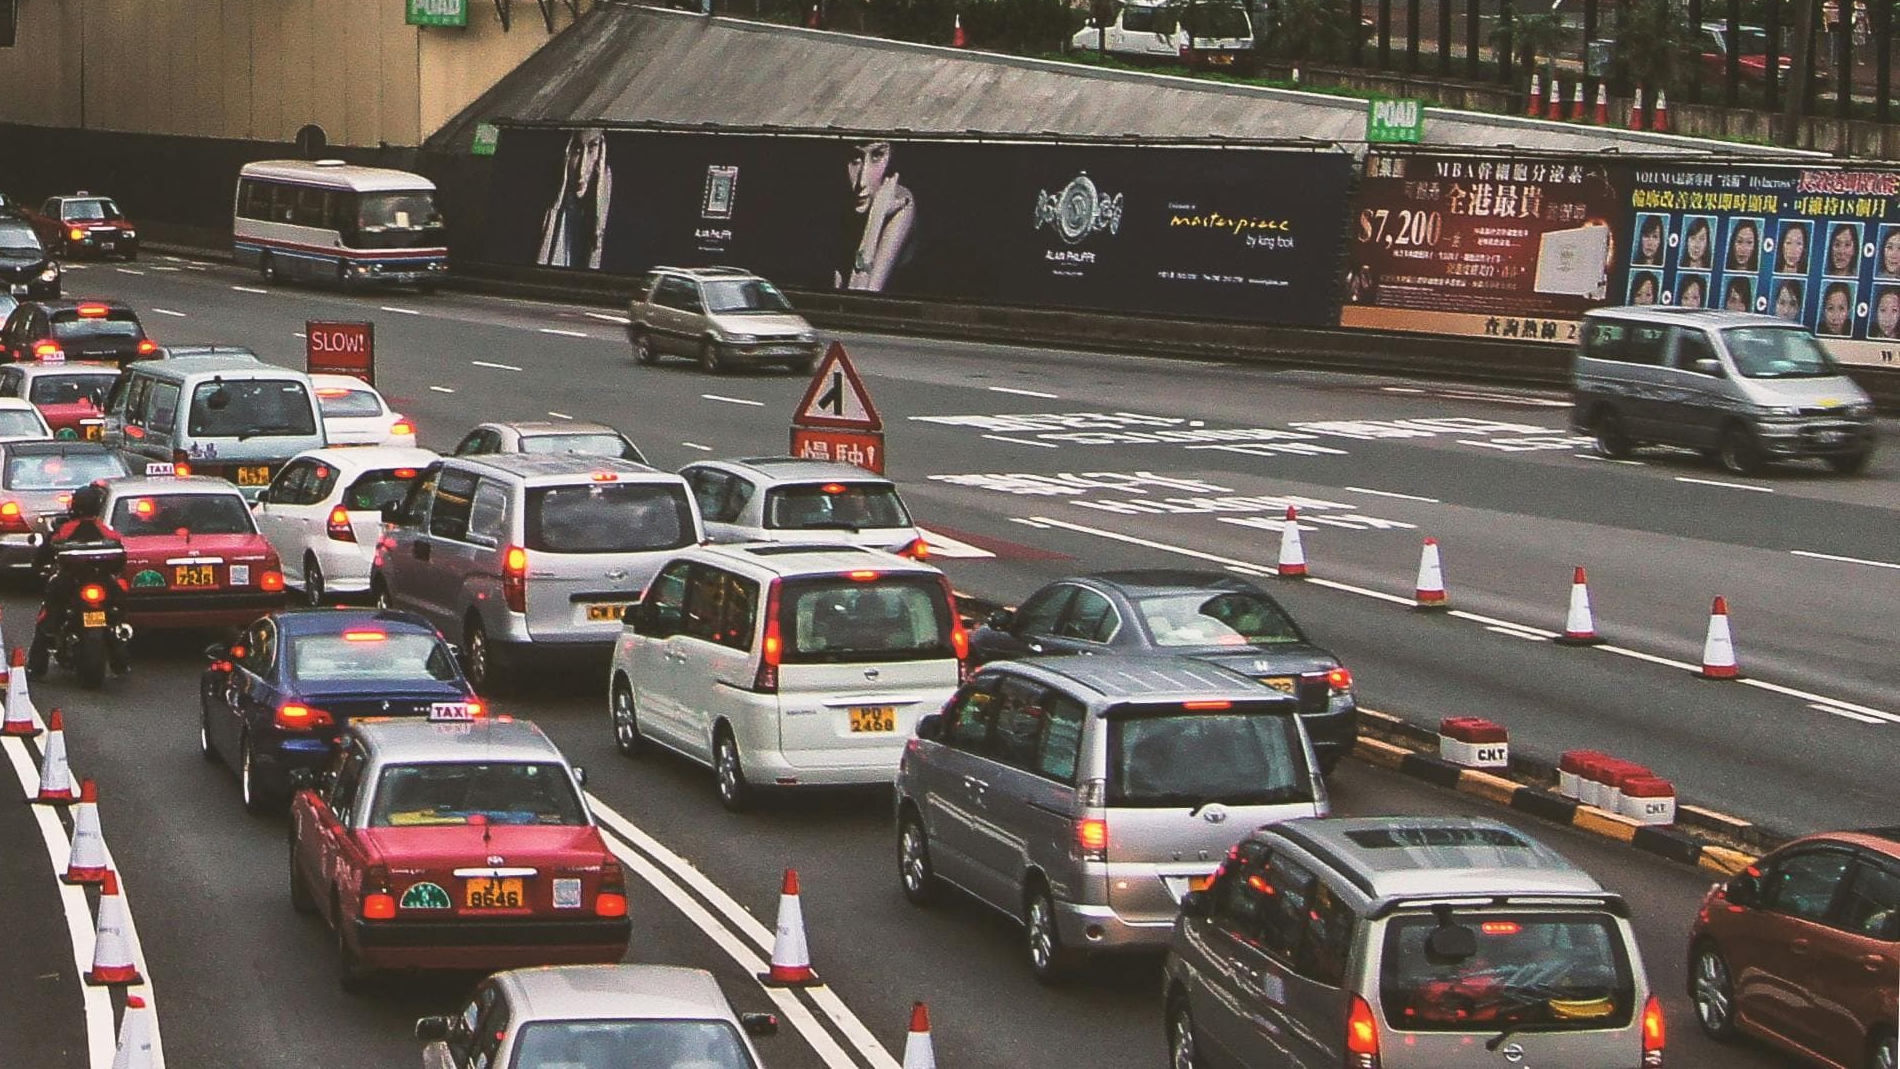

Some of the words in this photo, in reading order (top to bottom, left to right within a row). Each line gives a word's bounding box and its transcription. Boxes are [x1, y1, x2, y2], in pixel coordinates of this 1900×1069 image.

[1447, 183, 1541, 218] 全港最貴
[1170, 212, 1290, 235] masterpiece
[1358, 208, 1442, 250] $7,200
[312, 331, 365, 353] SLOW!
[149, 466, 173, 475] TAXI
[435, 706, 469, 718] TAXI
